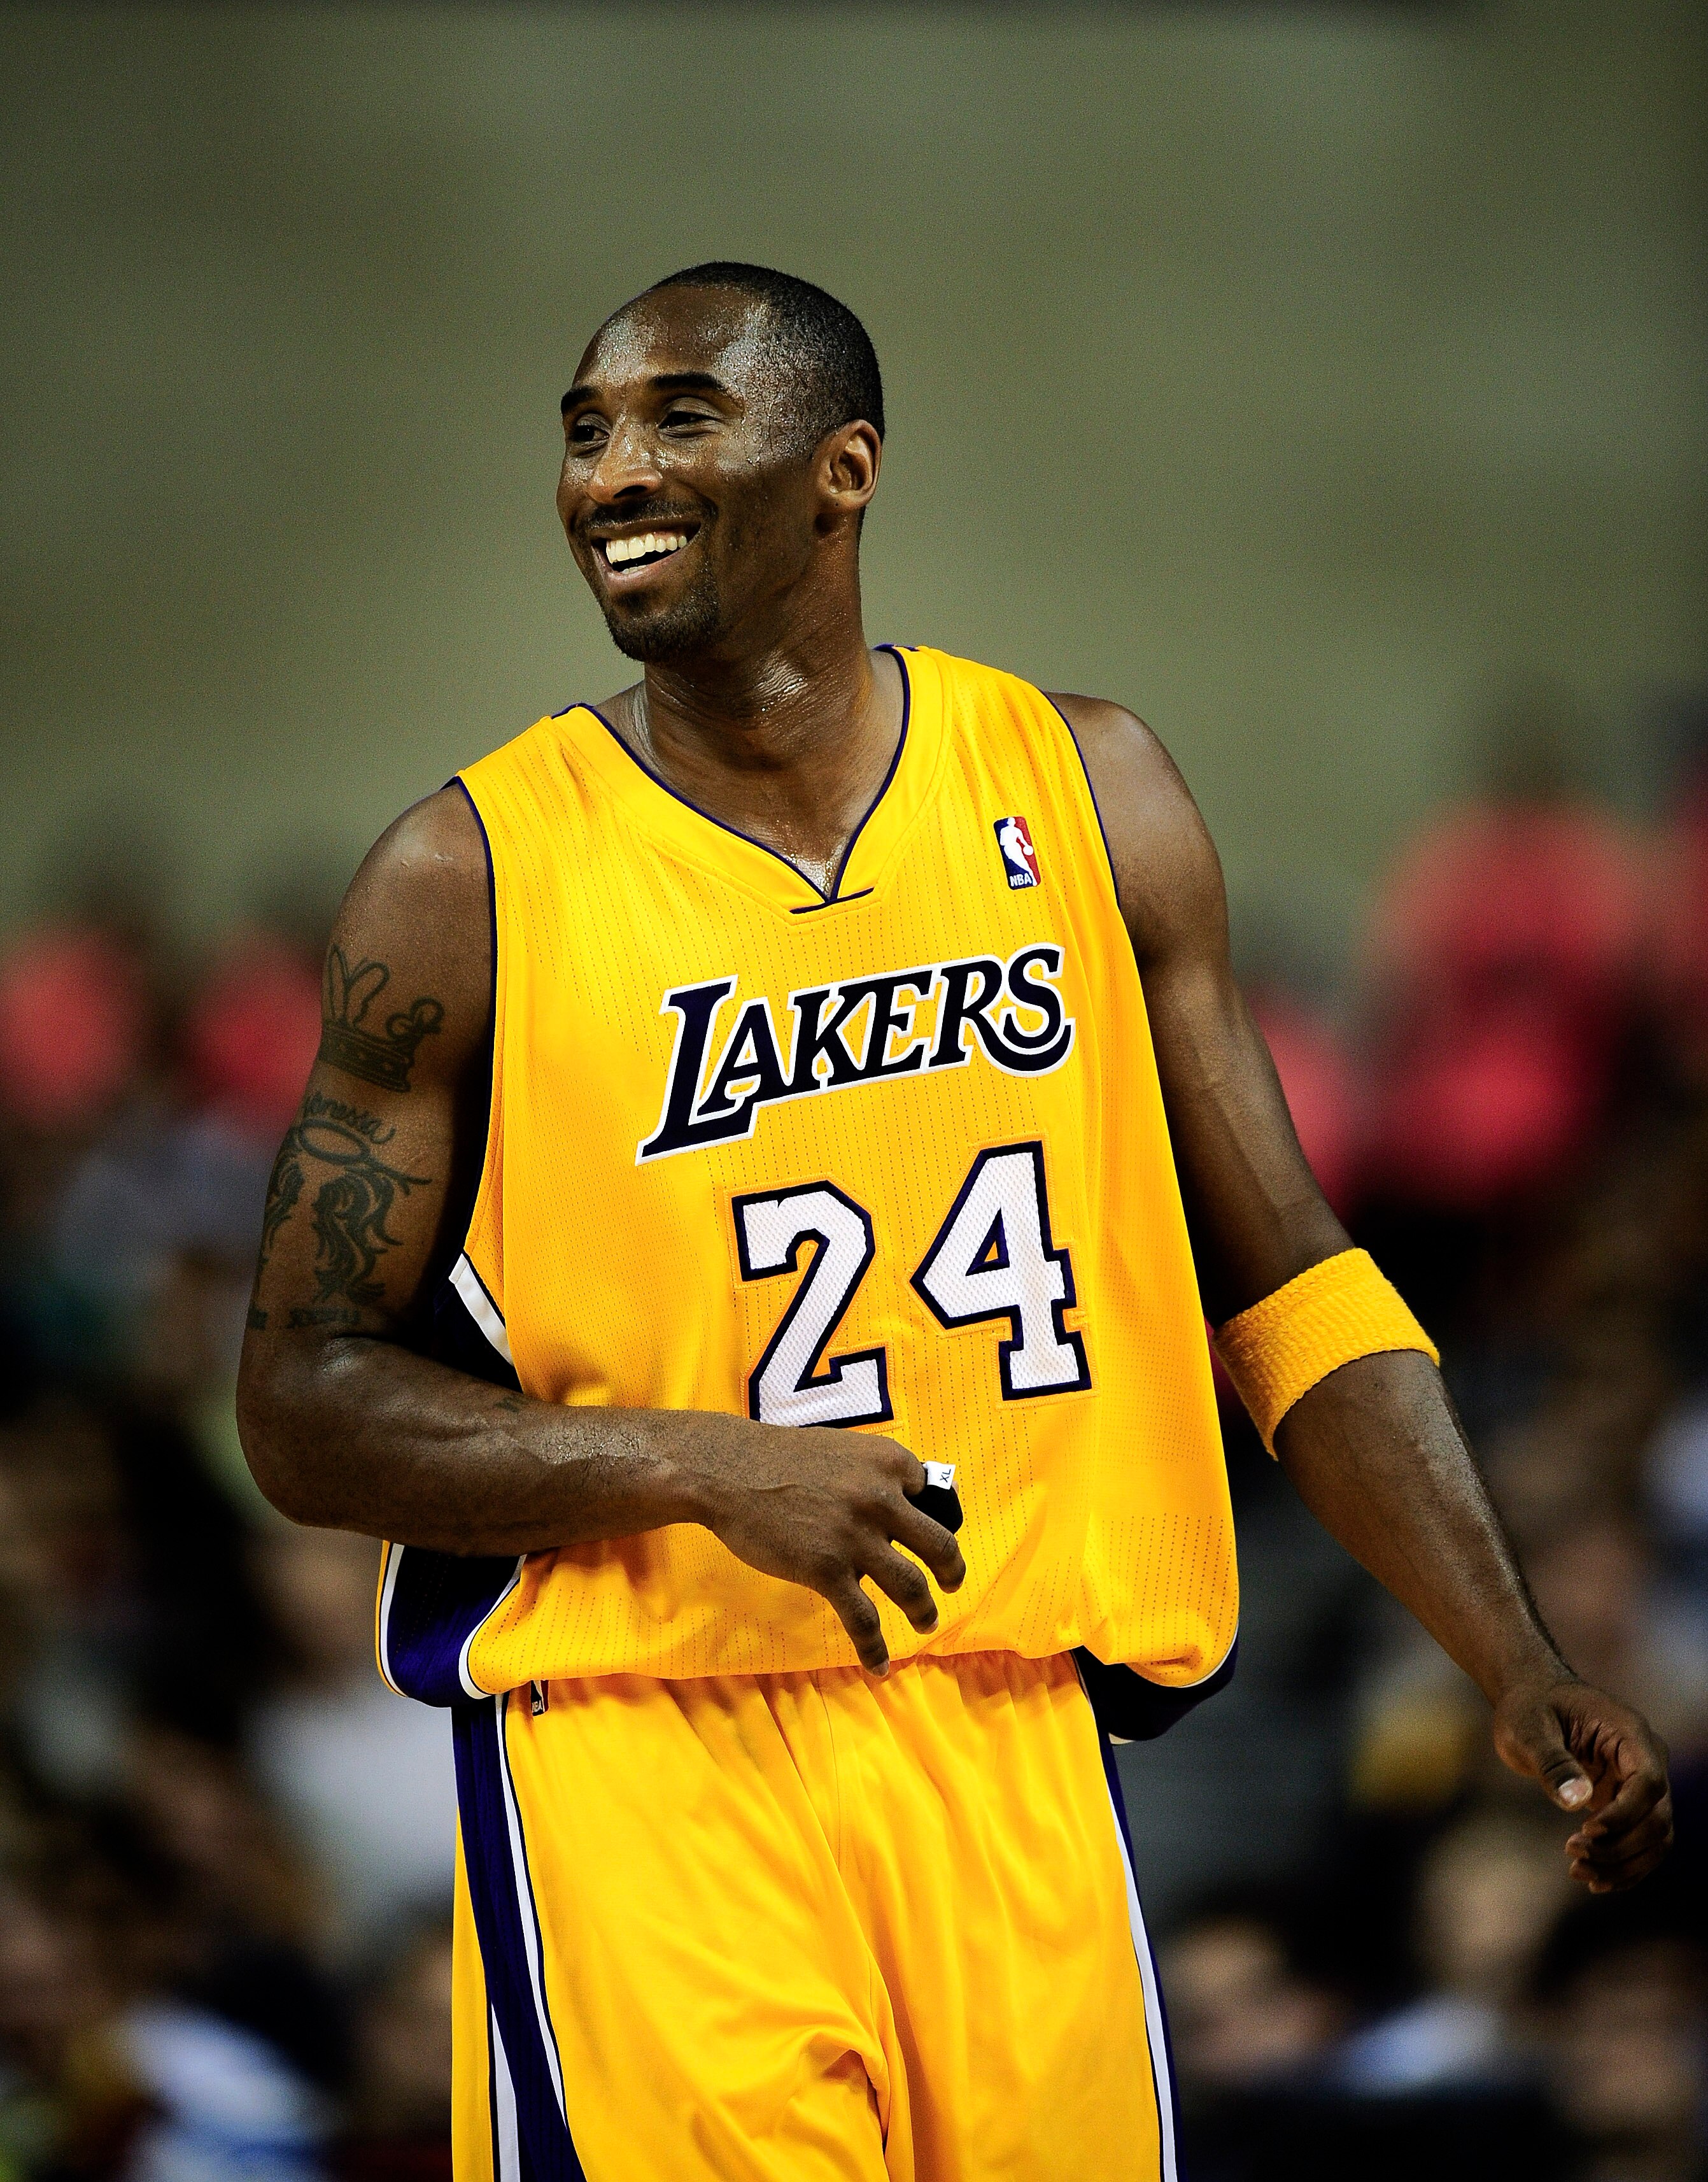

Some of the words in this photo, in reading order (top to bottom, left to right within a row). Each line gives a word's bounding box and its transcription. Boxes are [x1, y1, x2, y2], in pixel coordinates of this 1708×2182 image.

[1009, 872, 1032, 886] NBA
[635, 942, 1076, 1166] LAKERS
[731, 1140, 1093, 1428] 24
[940, 1469, 951, 1483] XL
